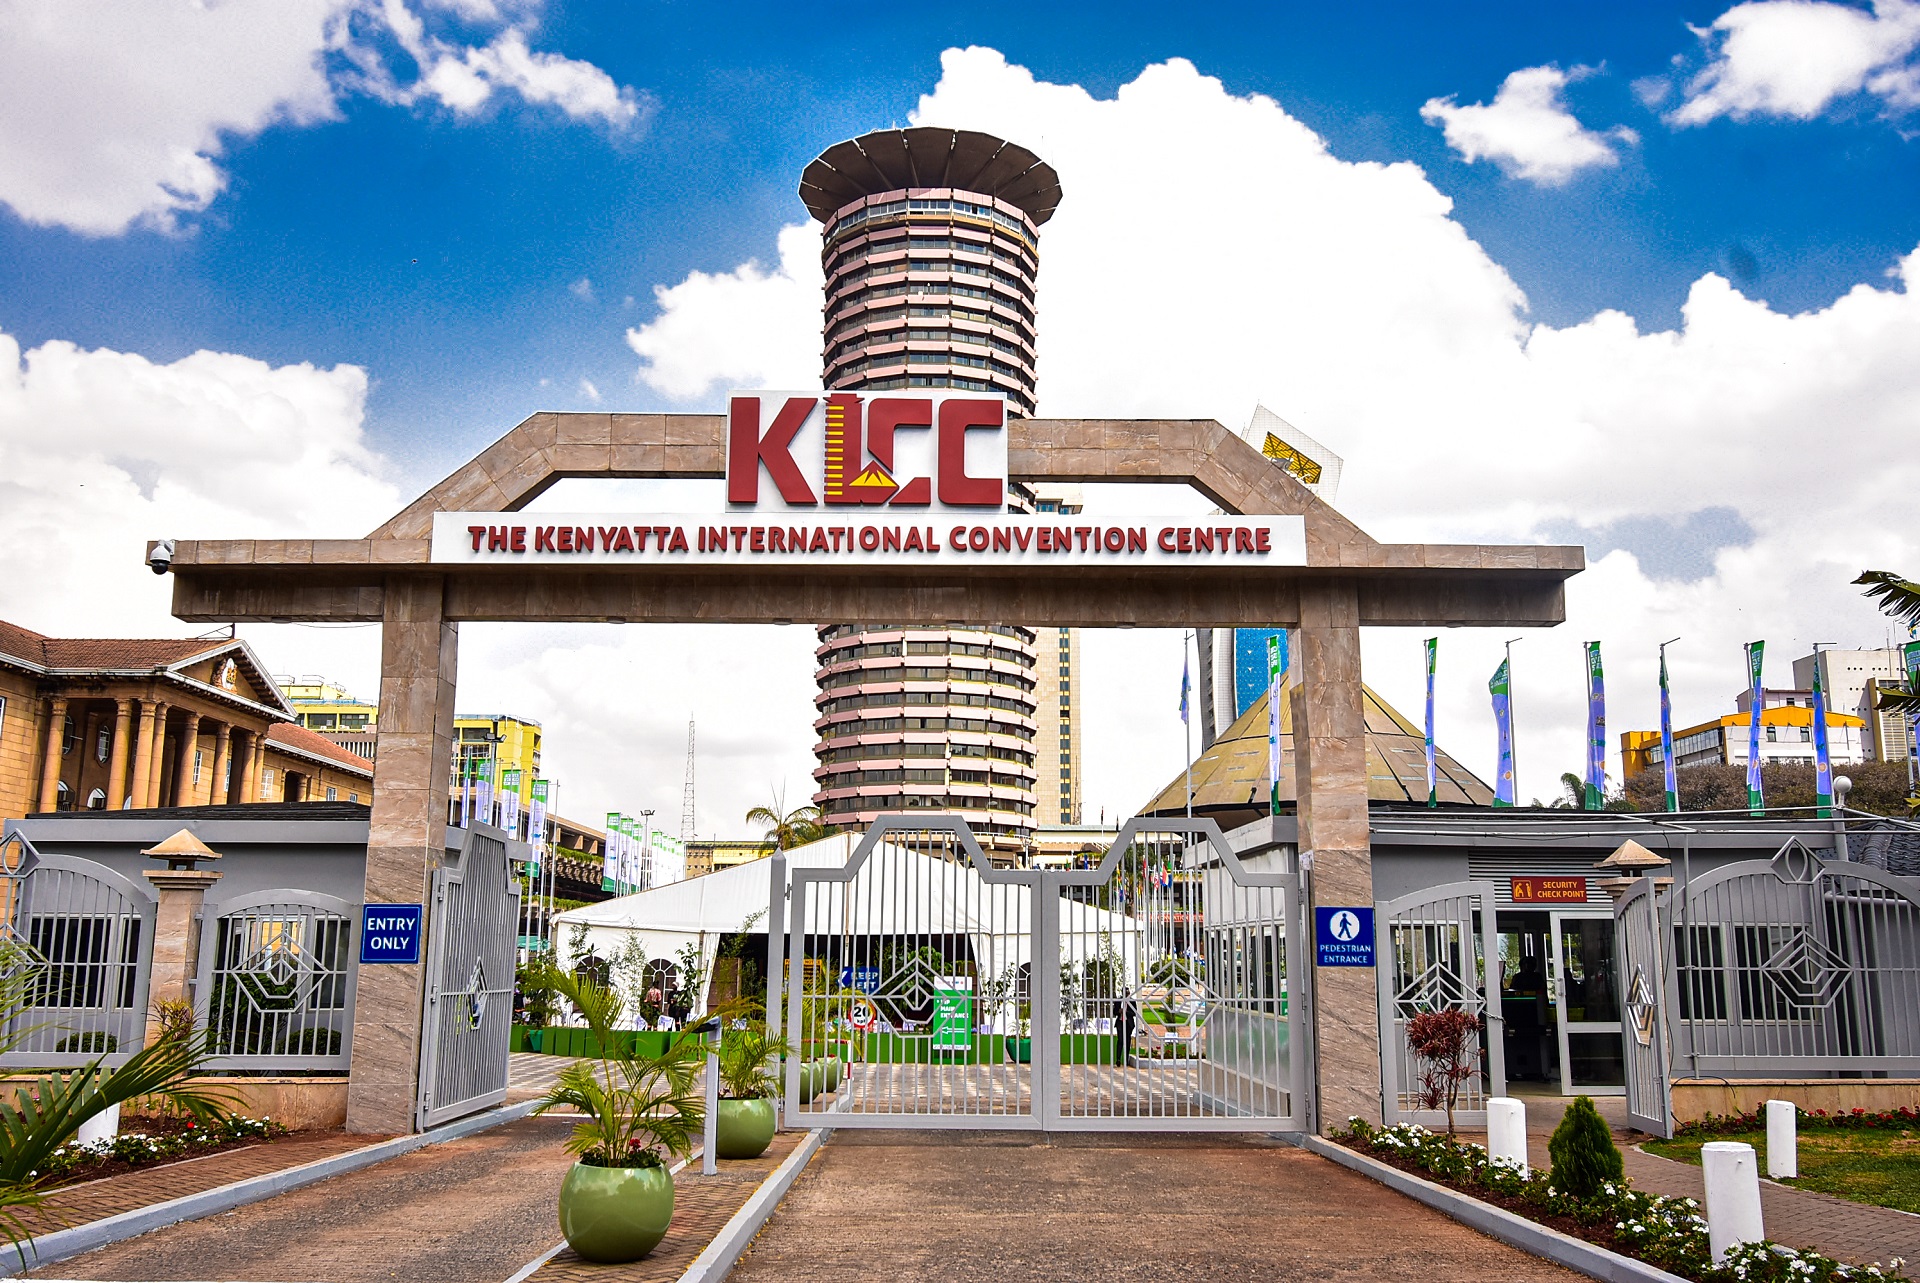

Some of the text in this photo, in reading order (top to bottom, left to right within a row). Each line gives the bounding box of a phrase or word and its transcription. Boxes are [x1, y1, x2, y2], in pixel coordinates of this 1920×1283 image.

[467, 525, 1272, 553] THE KENYATTA INTERNATIONAL CONVENTION CENTRE
[1542, 881, 1578, 889] SECURITY
[1537, 890, 1585, 898] CHECK POINT
[367, 917, 416, 931] ENTRY
[370, 936, 410, 950] ONLY
[1320, 944, 1371, 953] PEDESTRIAN
[1323, 955, 1368, 964] ENTRANCE
